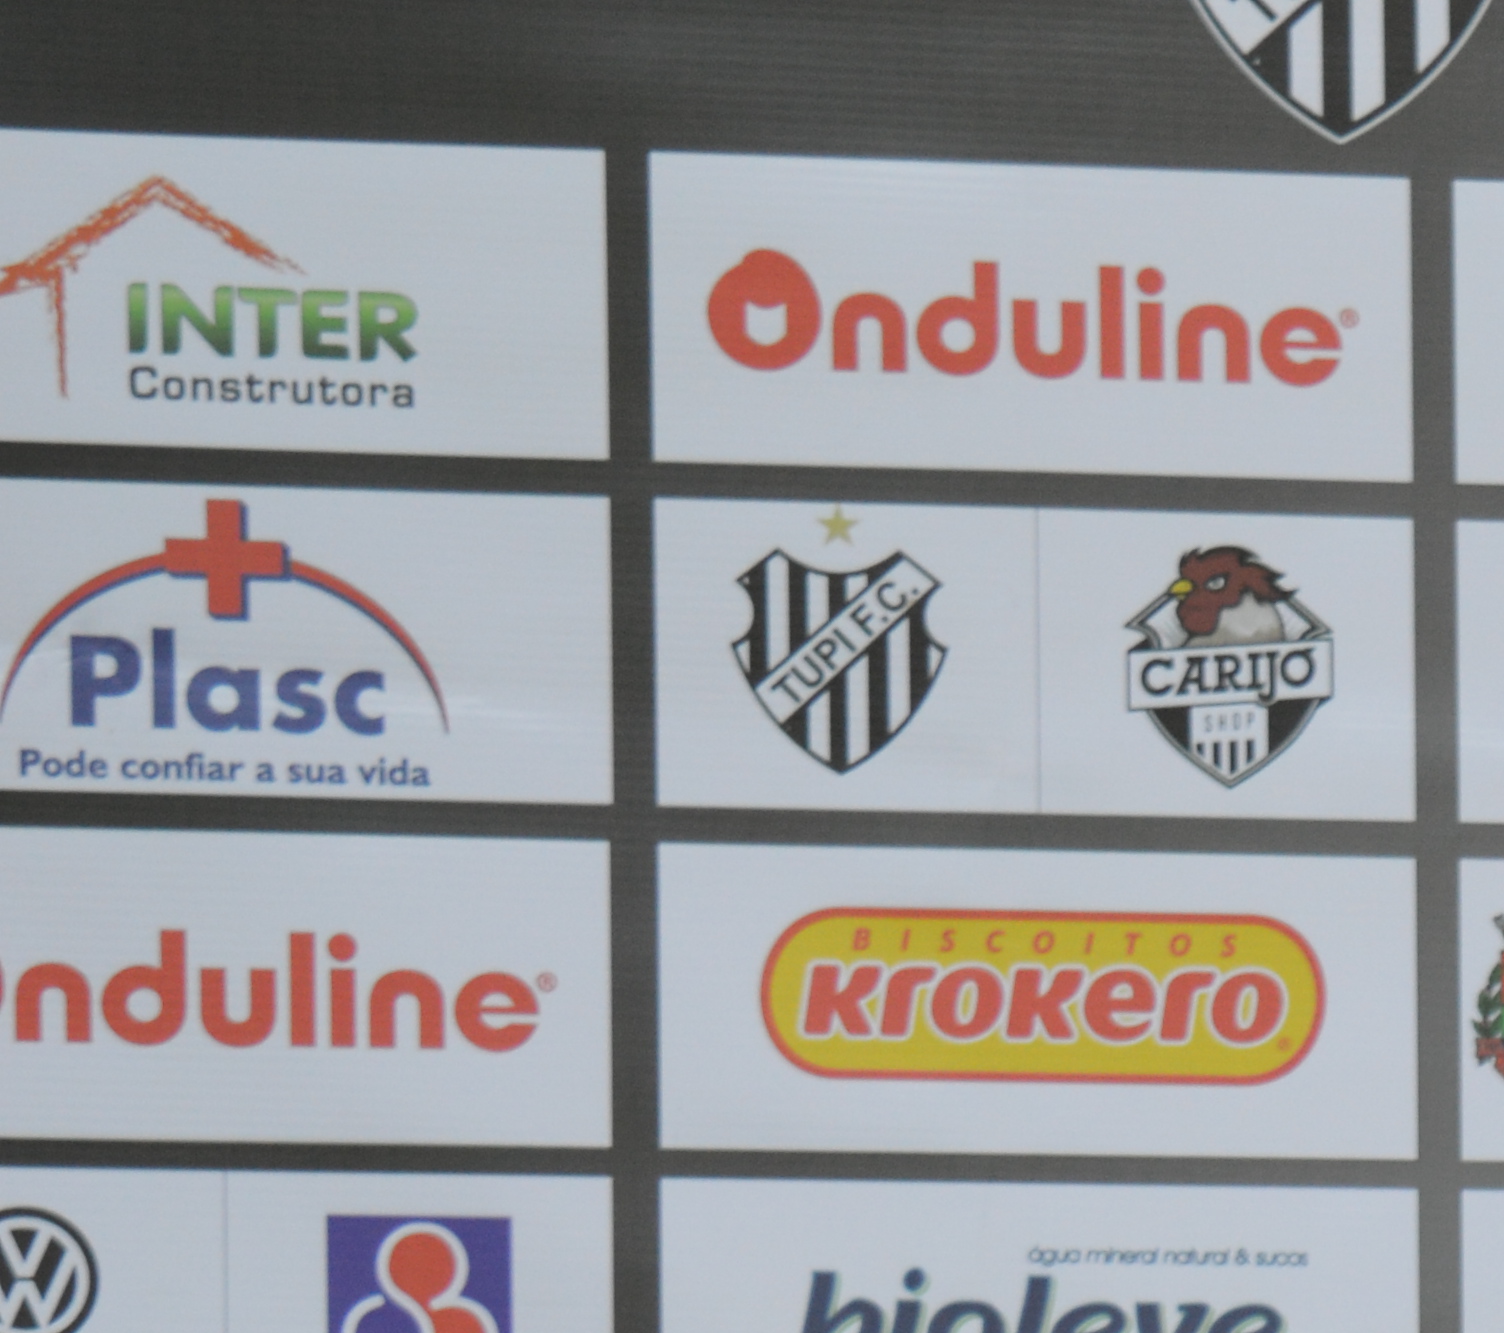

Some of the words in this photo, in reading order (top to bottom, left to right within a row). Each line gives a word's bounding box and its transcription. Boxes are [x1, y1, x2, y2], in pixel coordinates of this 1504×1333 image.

[127, 283, 417, 362] INTER
[128, 365, 414, 408] Construtora
[69, 627, 384, 736] Plasc
[20, 749, 106, 778] Pode
[121, 753, 243, 780] confiar
[257, 763, 274, 782] a
[288, 764, 345, 784] sua
[358, 758, 430, 787] vida
[853, 928, 1237, 960] BISCOITOS
[0, 929, 539, 1053] nduline
